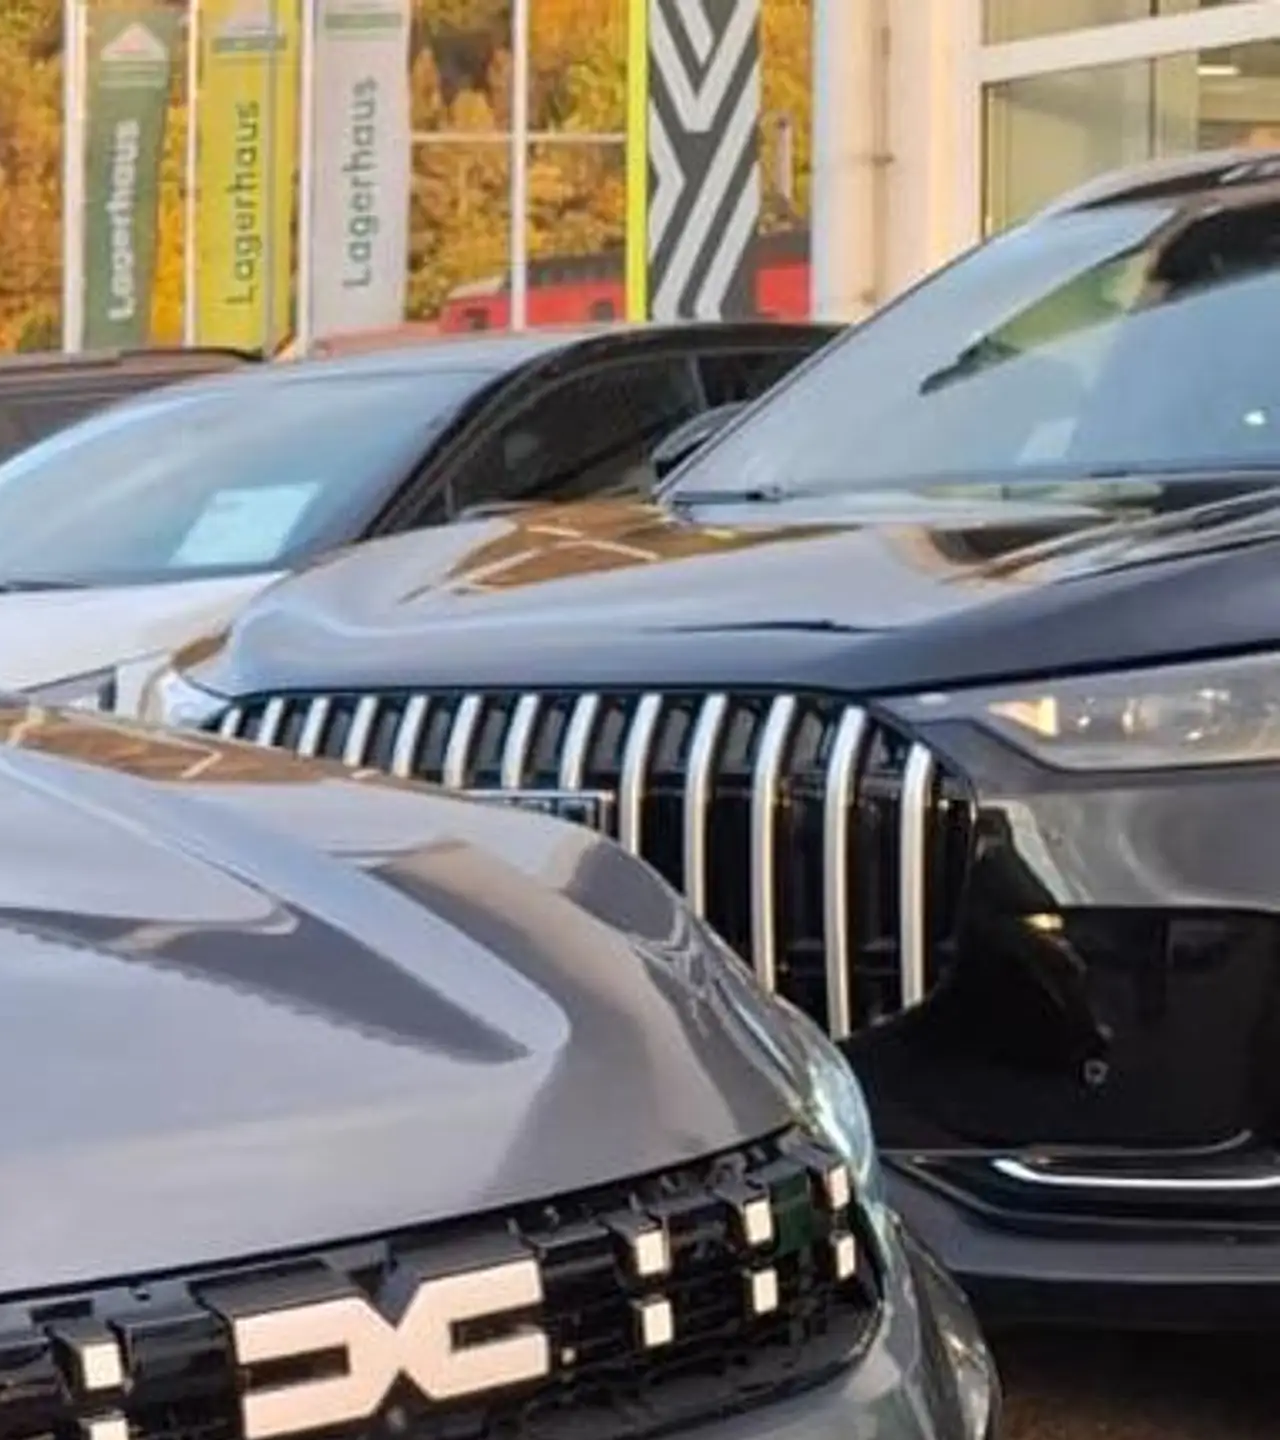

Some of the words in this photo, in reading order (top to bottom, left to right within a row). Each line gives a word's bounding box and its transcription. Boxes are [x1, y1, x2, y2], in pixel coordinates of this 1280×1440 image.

[106, 120, 141, 319] Lagerhaus
[225, 101, 260, 307] Lagerhaus
[343, 76, 379, 289] Lagerhaus
